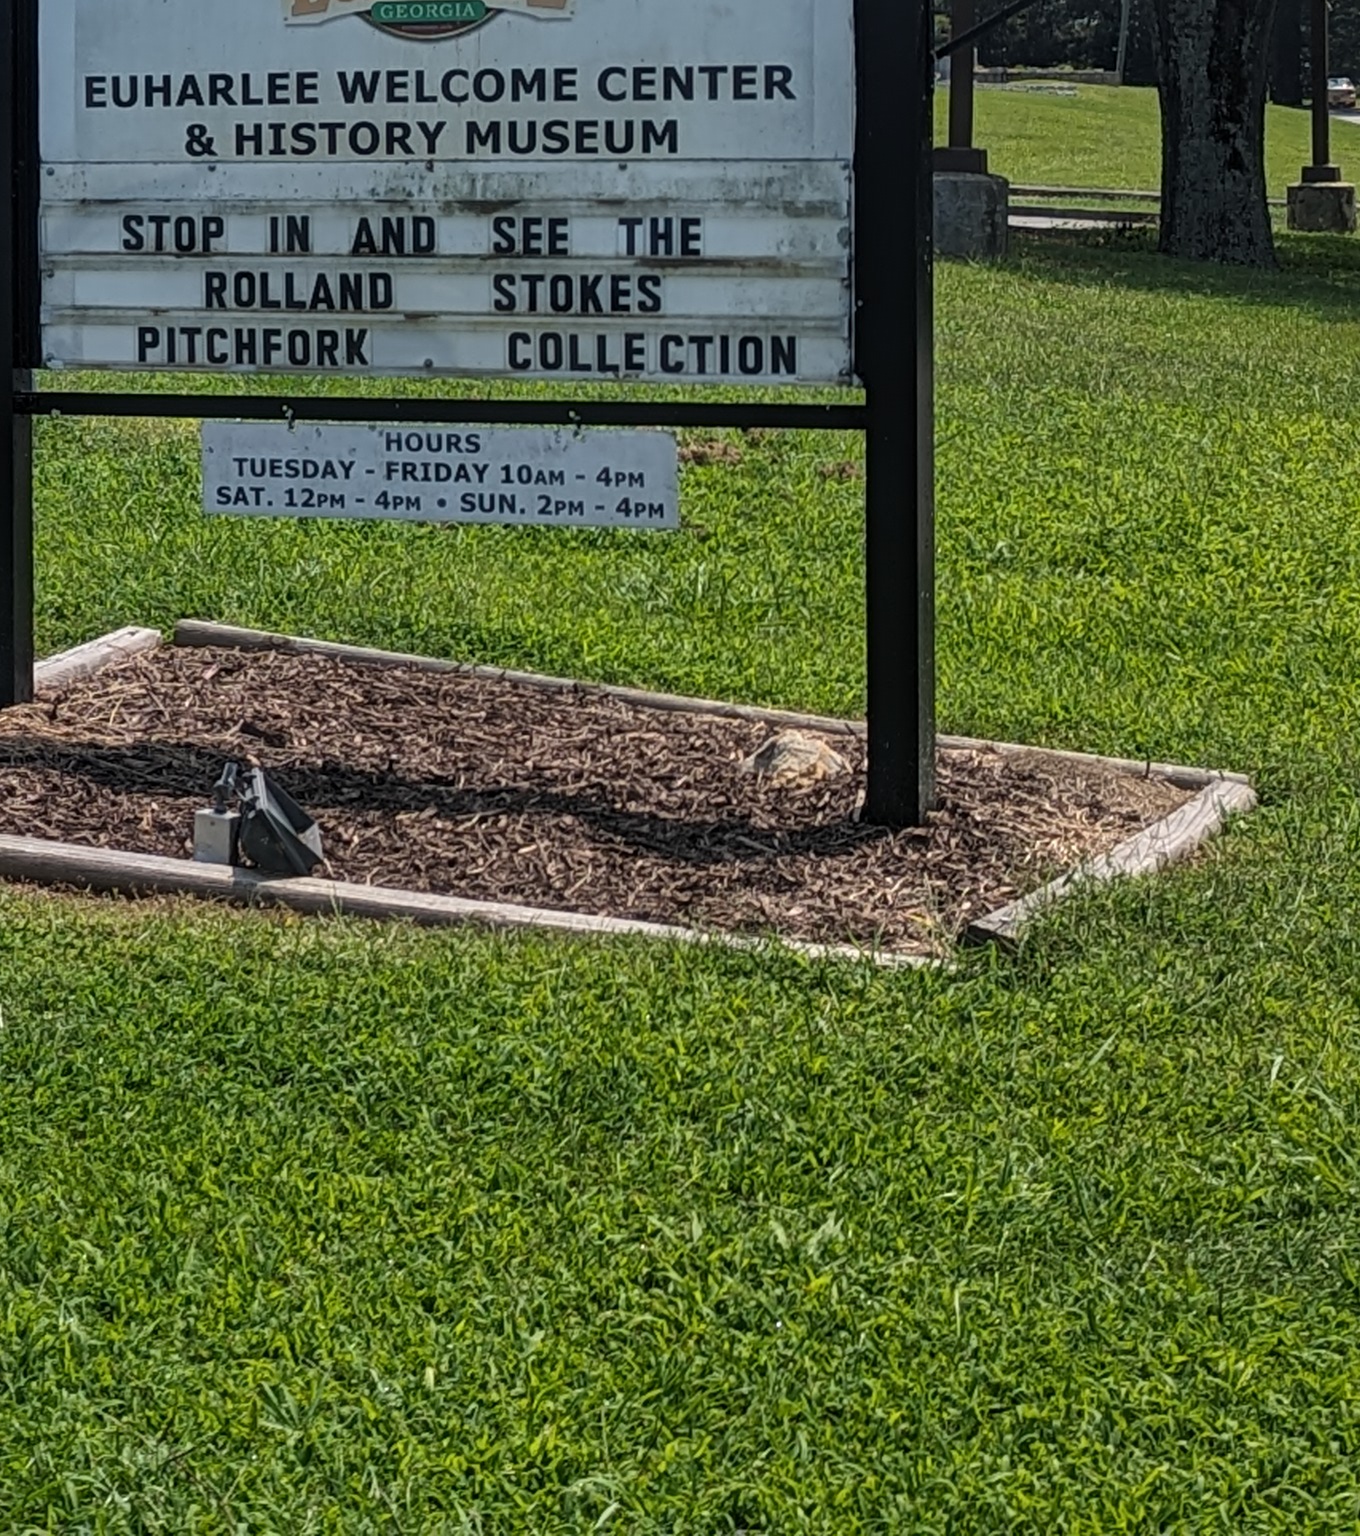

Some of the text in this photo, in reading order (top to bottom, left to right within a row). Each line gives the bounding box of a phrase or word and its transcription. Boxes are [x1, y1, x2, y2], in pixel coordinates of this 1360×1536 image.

[380, 2, 476, 20] GEORGIA
[85, 65, 797, 108] EUHARLEE WELCOME CENTER
[185, 119, 679, 157] & HISTORY MUSEUM
[122, 215, 702, 256] STOP IN AND SEE THE
[205, 271, 662, 313] ROLLAND STOKES
[137, 326, 797, 375] PITCHFORK COLLECTION
[385, 432, 481, 453] HOURS
[233, 457, 356, 480] TUESDAY
[386, 461, 489, 484] FRIDAY
[500, 464, 565, 486] 10AM
[596, 466, 645, 488] 4PM
[216, 486, 273, 506] SAT.
[284, 488, 345, 508] 12PM
[374, 490, 421, 511] 4PM
[460, 492, 526, 514] SUN.
[537, 494, 584, 516] 2PM
[615, 497, 665, 519] 4PM
